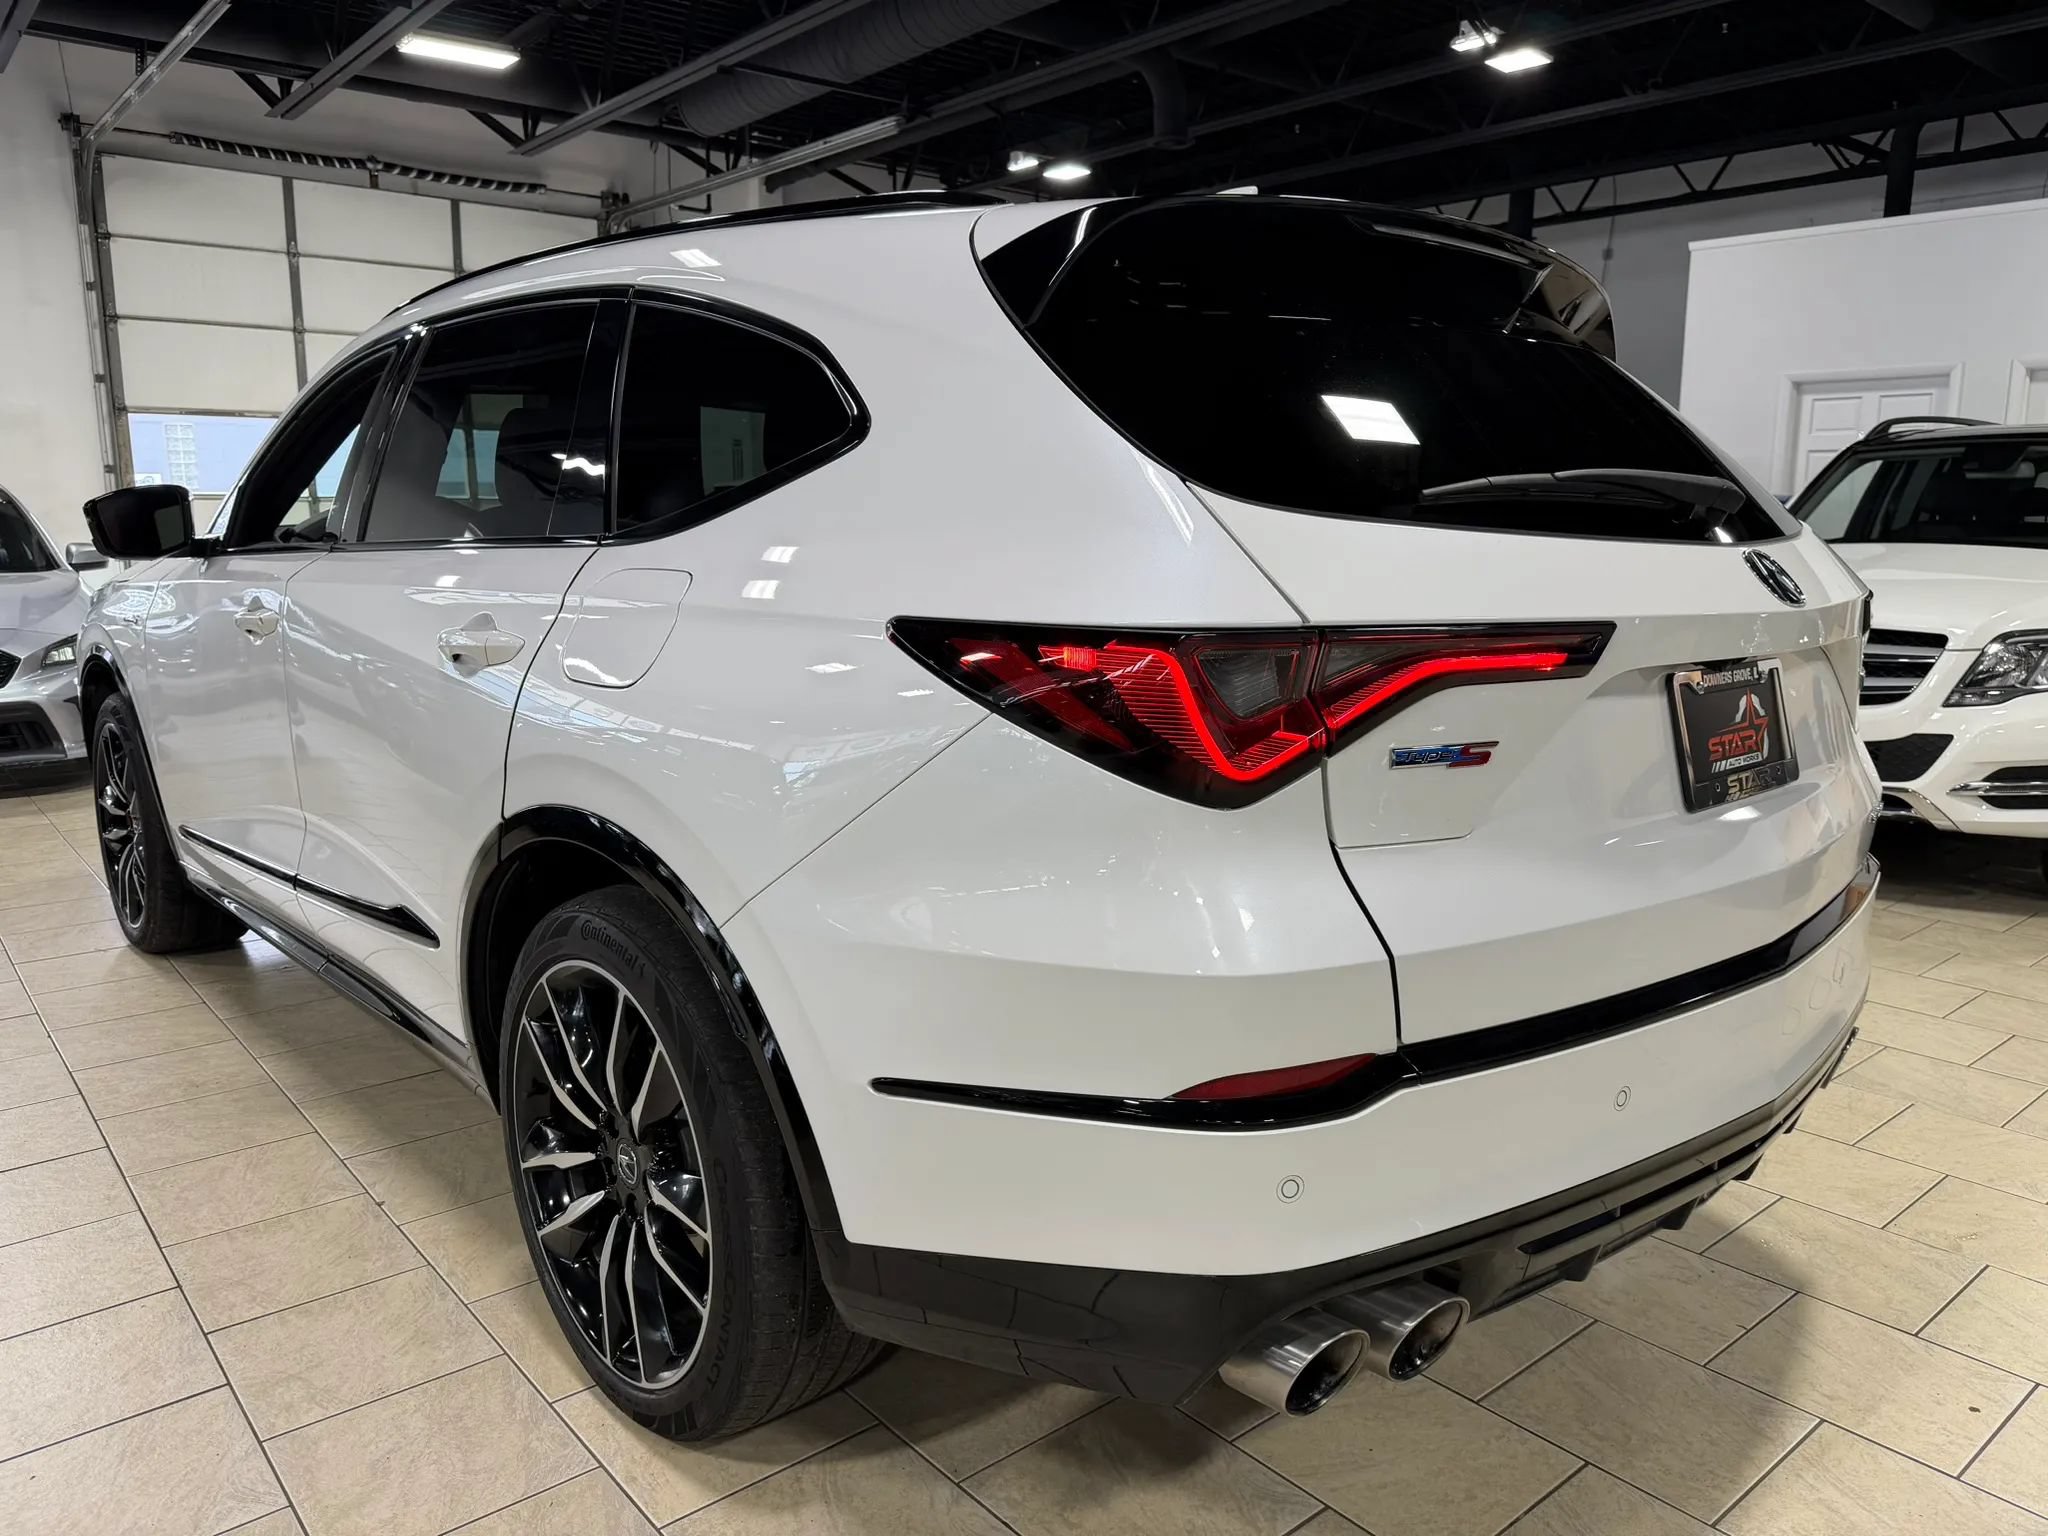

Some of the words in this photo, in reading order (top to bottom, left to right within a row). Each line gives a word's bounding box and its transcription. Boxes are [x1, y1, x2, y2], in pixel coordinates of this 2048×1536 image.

[1703, 671, 1733, 688] DOWNERS
[1708, 729, 1758, 760] STAR
[1728, 758, 1742, 767] AUTO
[1742, 753, 1760, 764] WORKS
[1727, 767, 1774, 793] STAR
[581, 920, 639, 971] Continental
